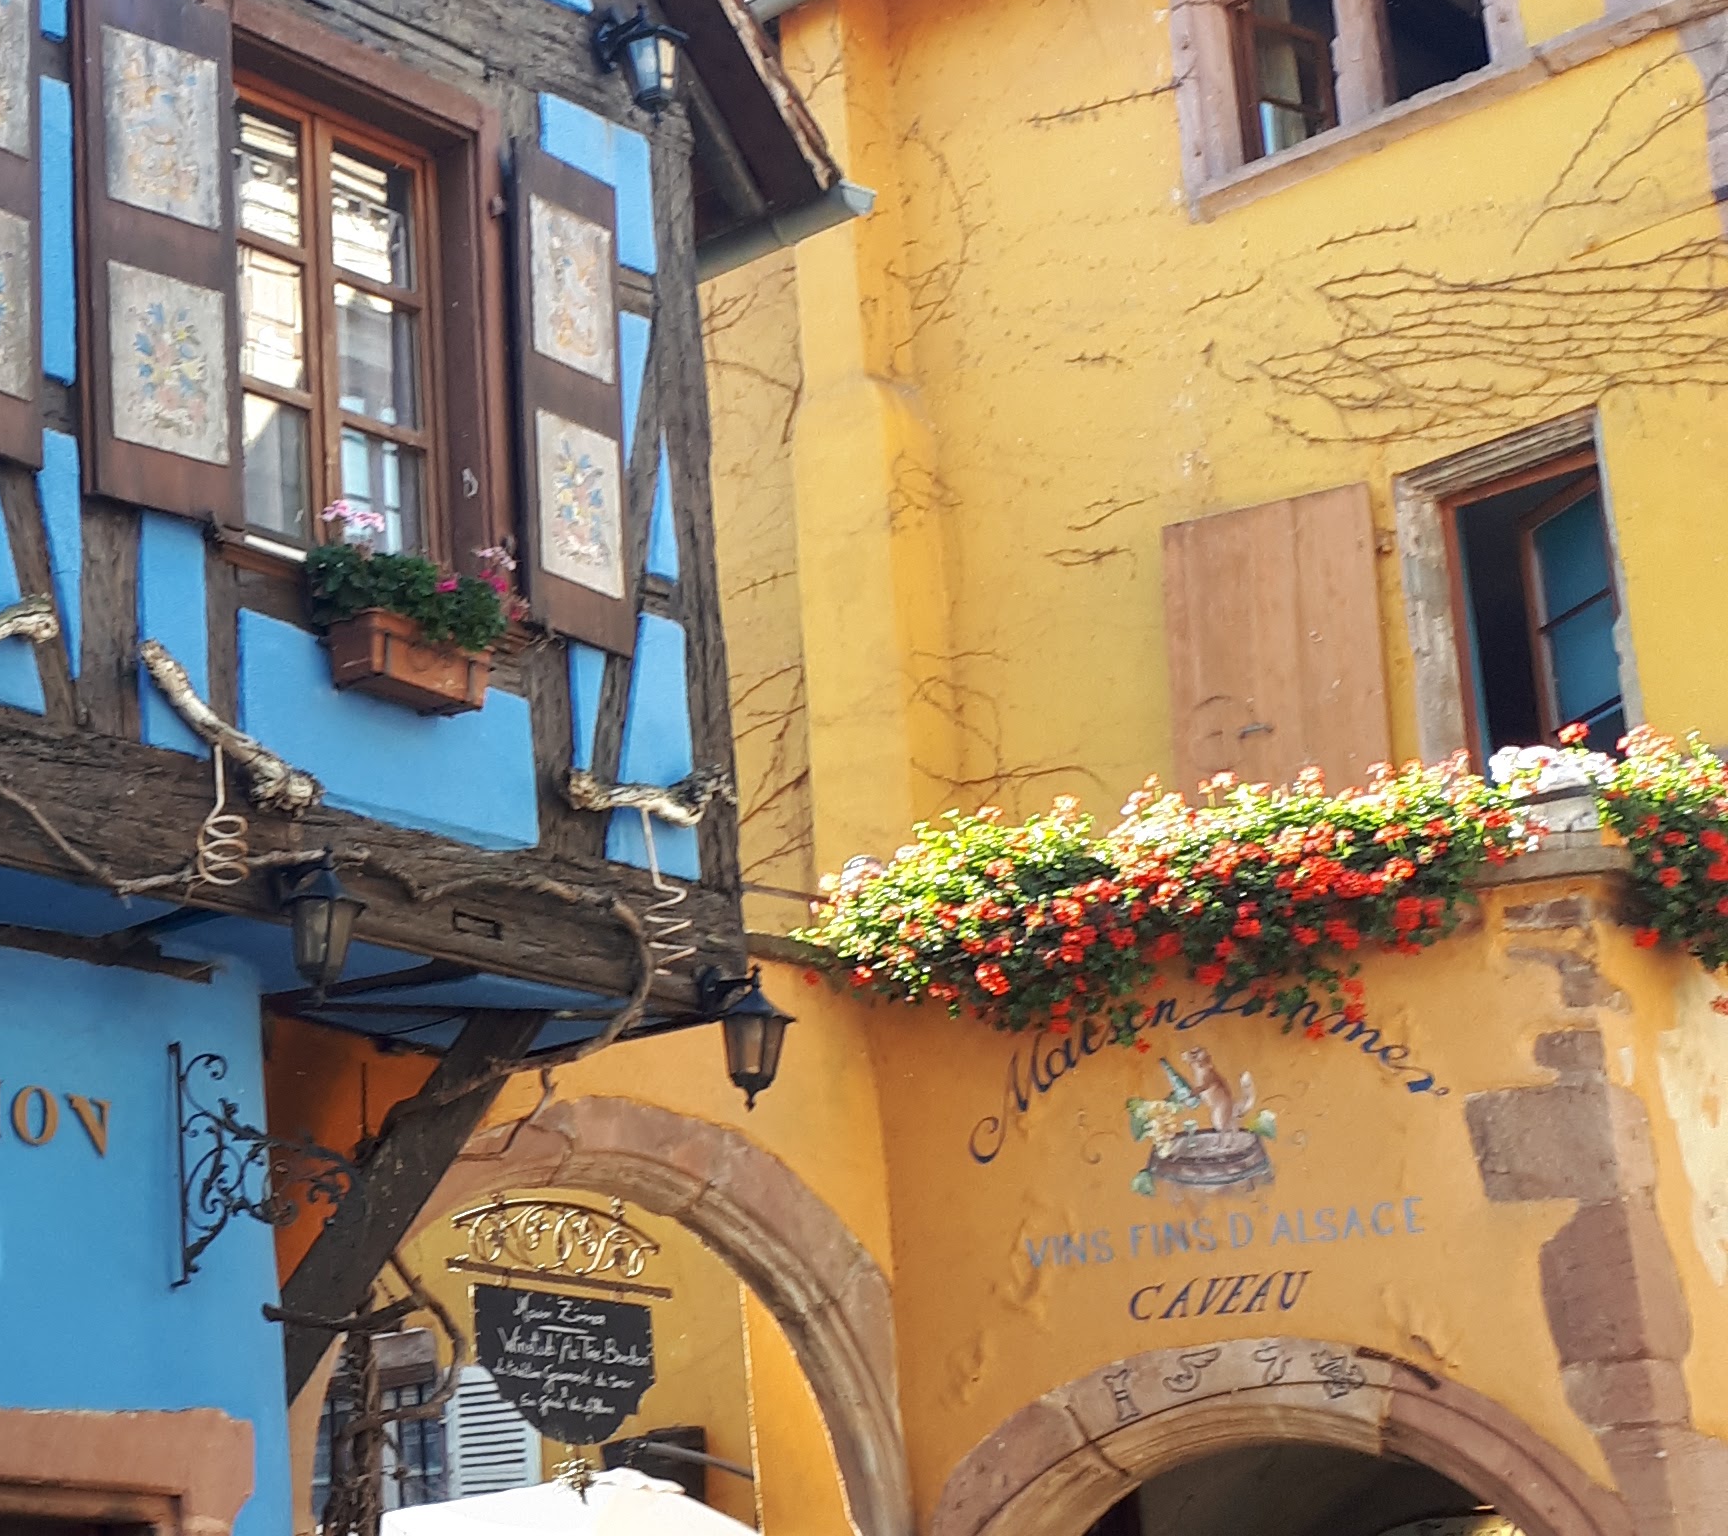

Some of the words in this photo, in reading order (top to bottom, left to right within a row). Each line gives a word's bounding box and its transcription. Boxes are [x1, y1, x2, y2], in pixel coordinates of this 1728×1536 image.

[1025, 1228, 1114, 1268] VINS
[1129, 1217, 1217, 1258] FINS
[1128, 1270, 1313, 1322] CAVEAU
